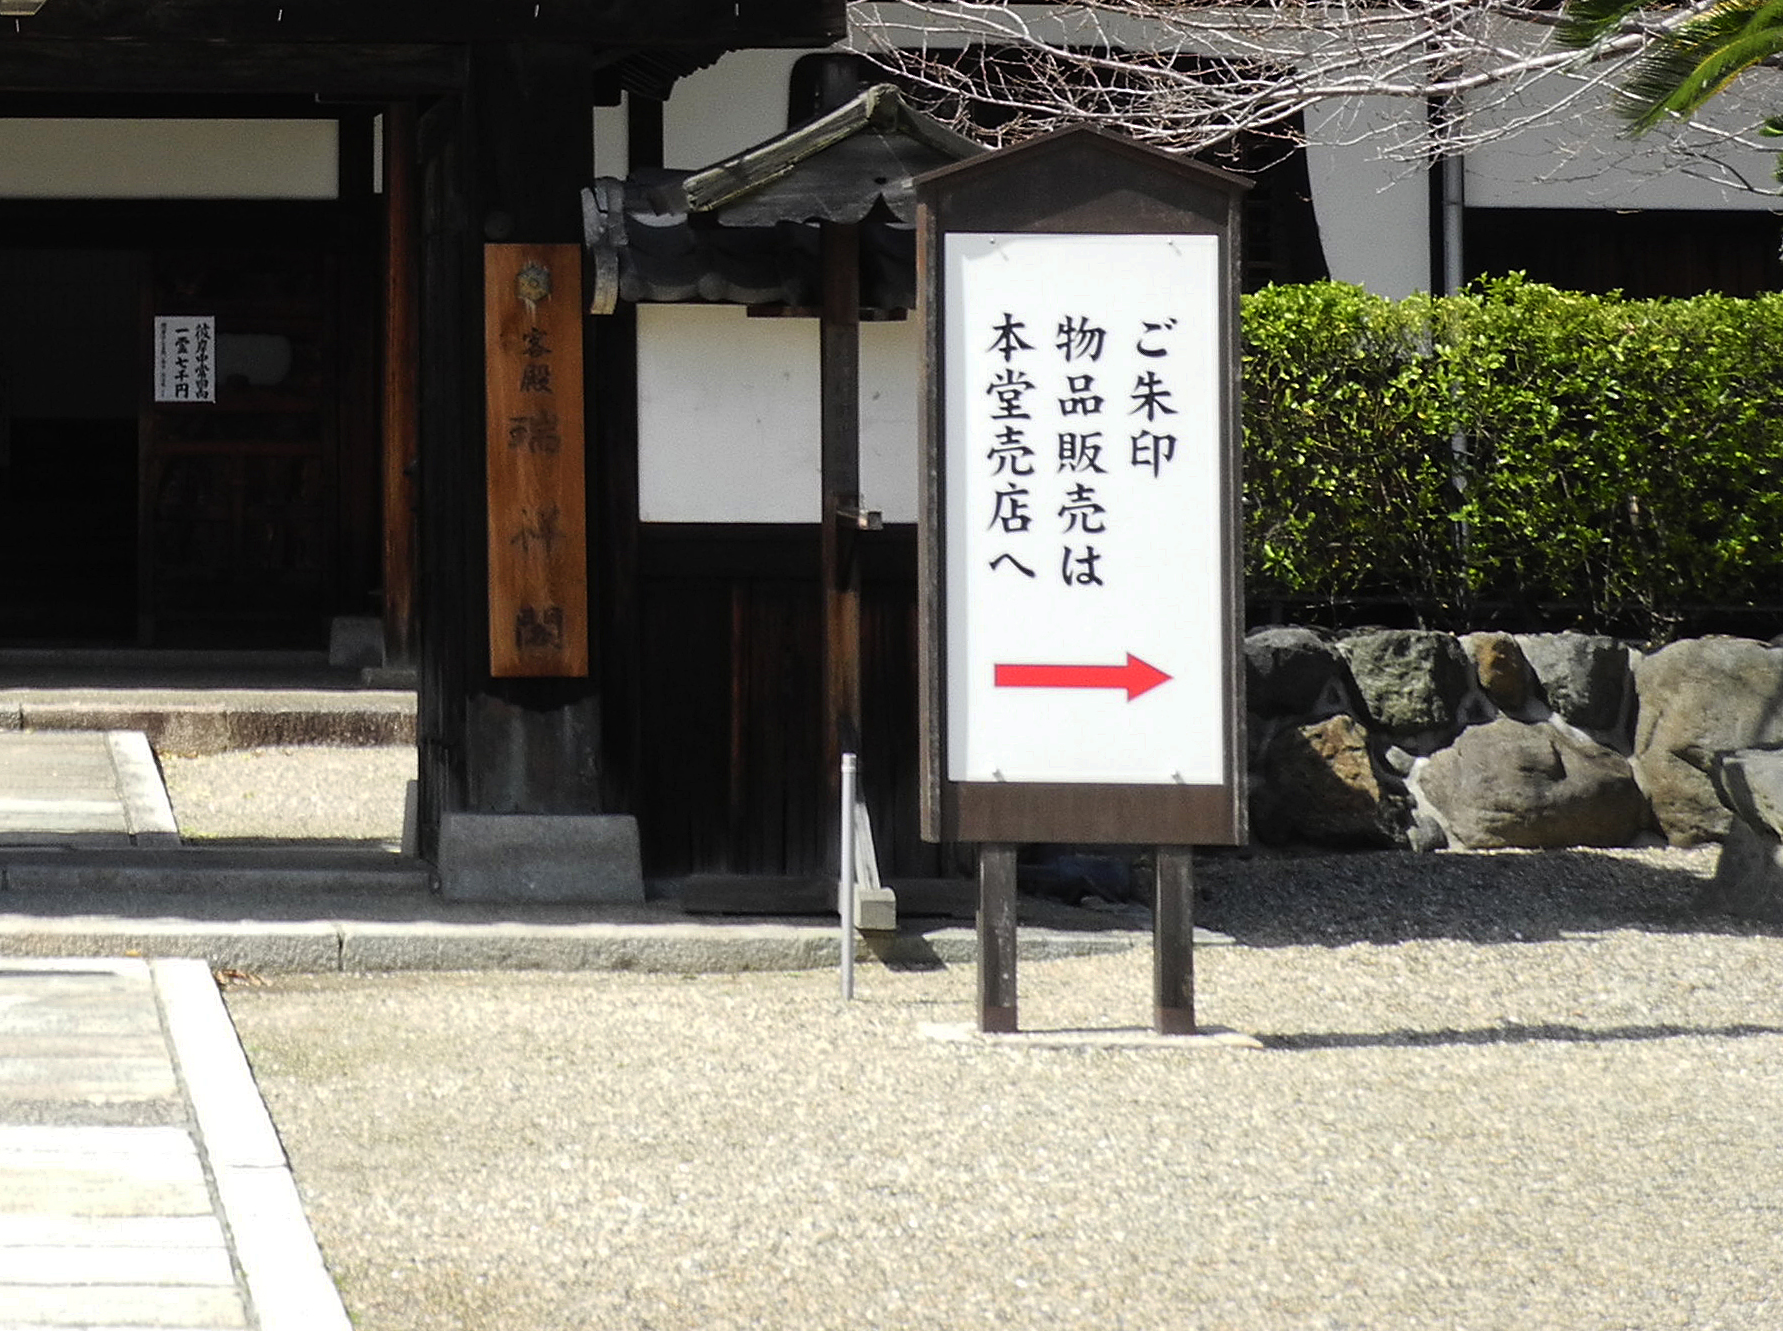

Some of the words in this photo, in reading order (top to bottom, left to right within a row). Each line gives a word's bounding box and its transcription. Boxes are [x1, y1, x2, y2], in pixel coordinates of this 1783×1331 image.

[519, 326, 552, 396] 客殿
[986, 313, 1035, 578] 本堂売店へ
[1056, 315, 1107, 586] 物品販売は
[1130, 318, 1178, 478] ご朱印
